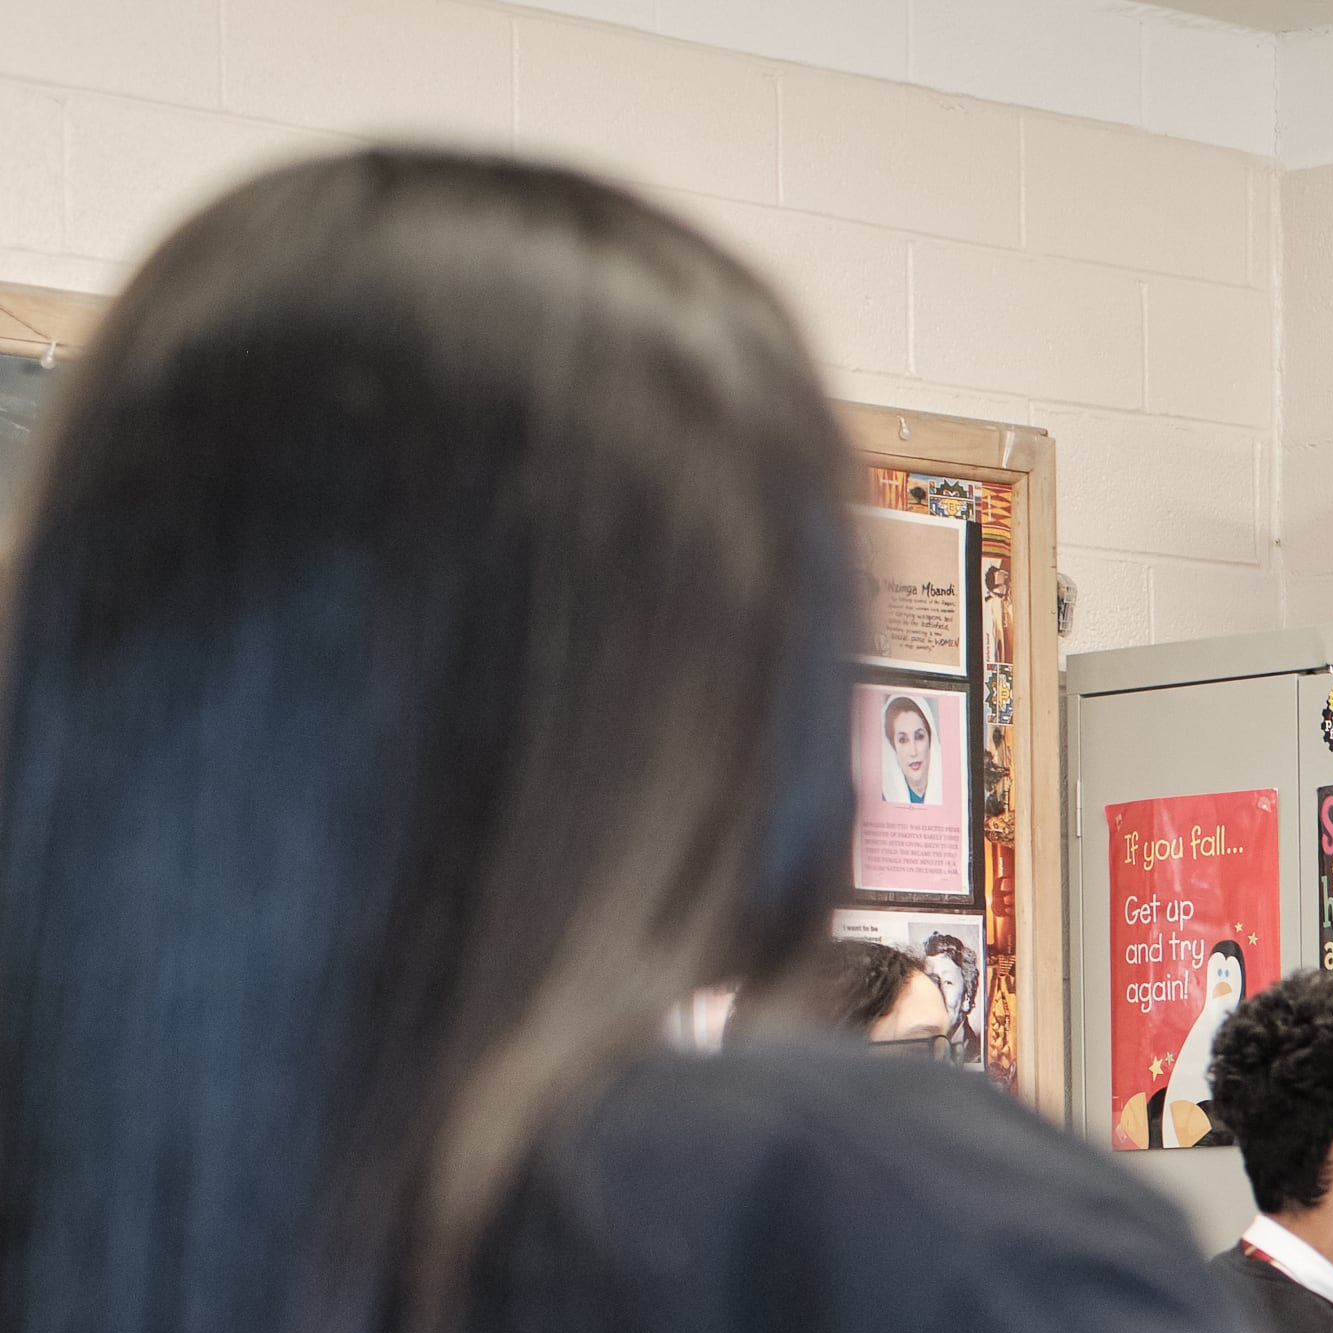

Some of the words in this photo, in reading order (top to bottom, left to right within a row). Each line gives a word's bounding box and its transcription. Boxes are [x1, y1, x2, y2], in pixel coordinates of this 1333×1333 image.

[922, 581, 955, 597] Mbandi
[1124, 831, 1138, 864] If
[1143, 836, 1183, 871] you
[1125, 894, 1160, 925] Get
[1166, 899, 1194, 931] up
[1125, 933, 1162, 965] and
[1169, 932, 1205, 968] try
[1126, 970, 1189, 1013] again!
